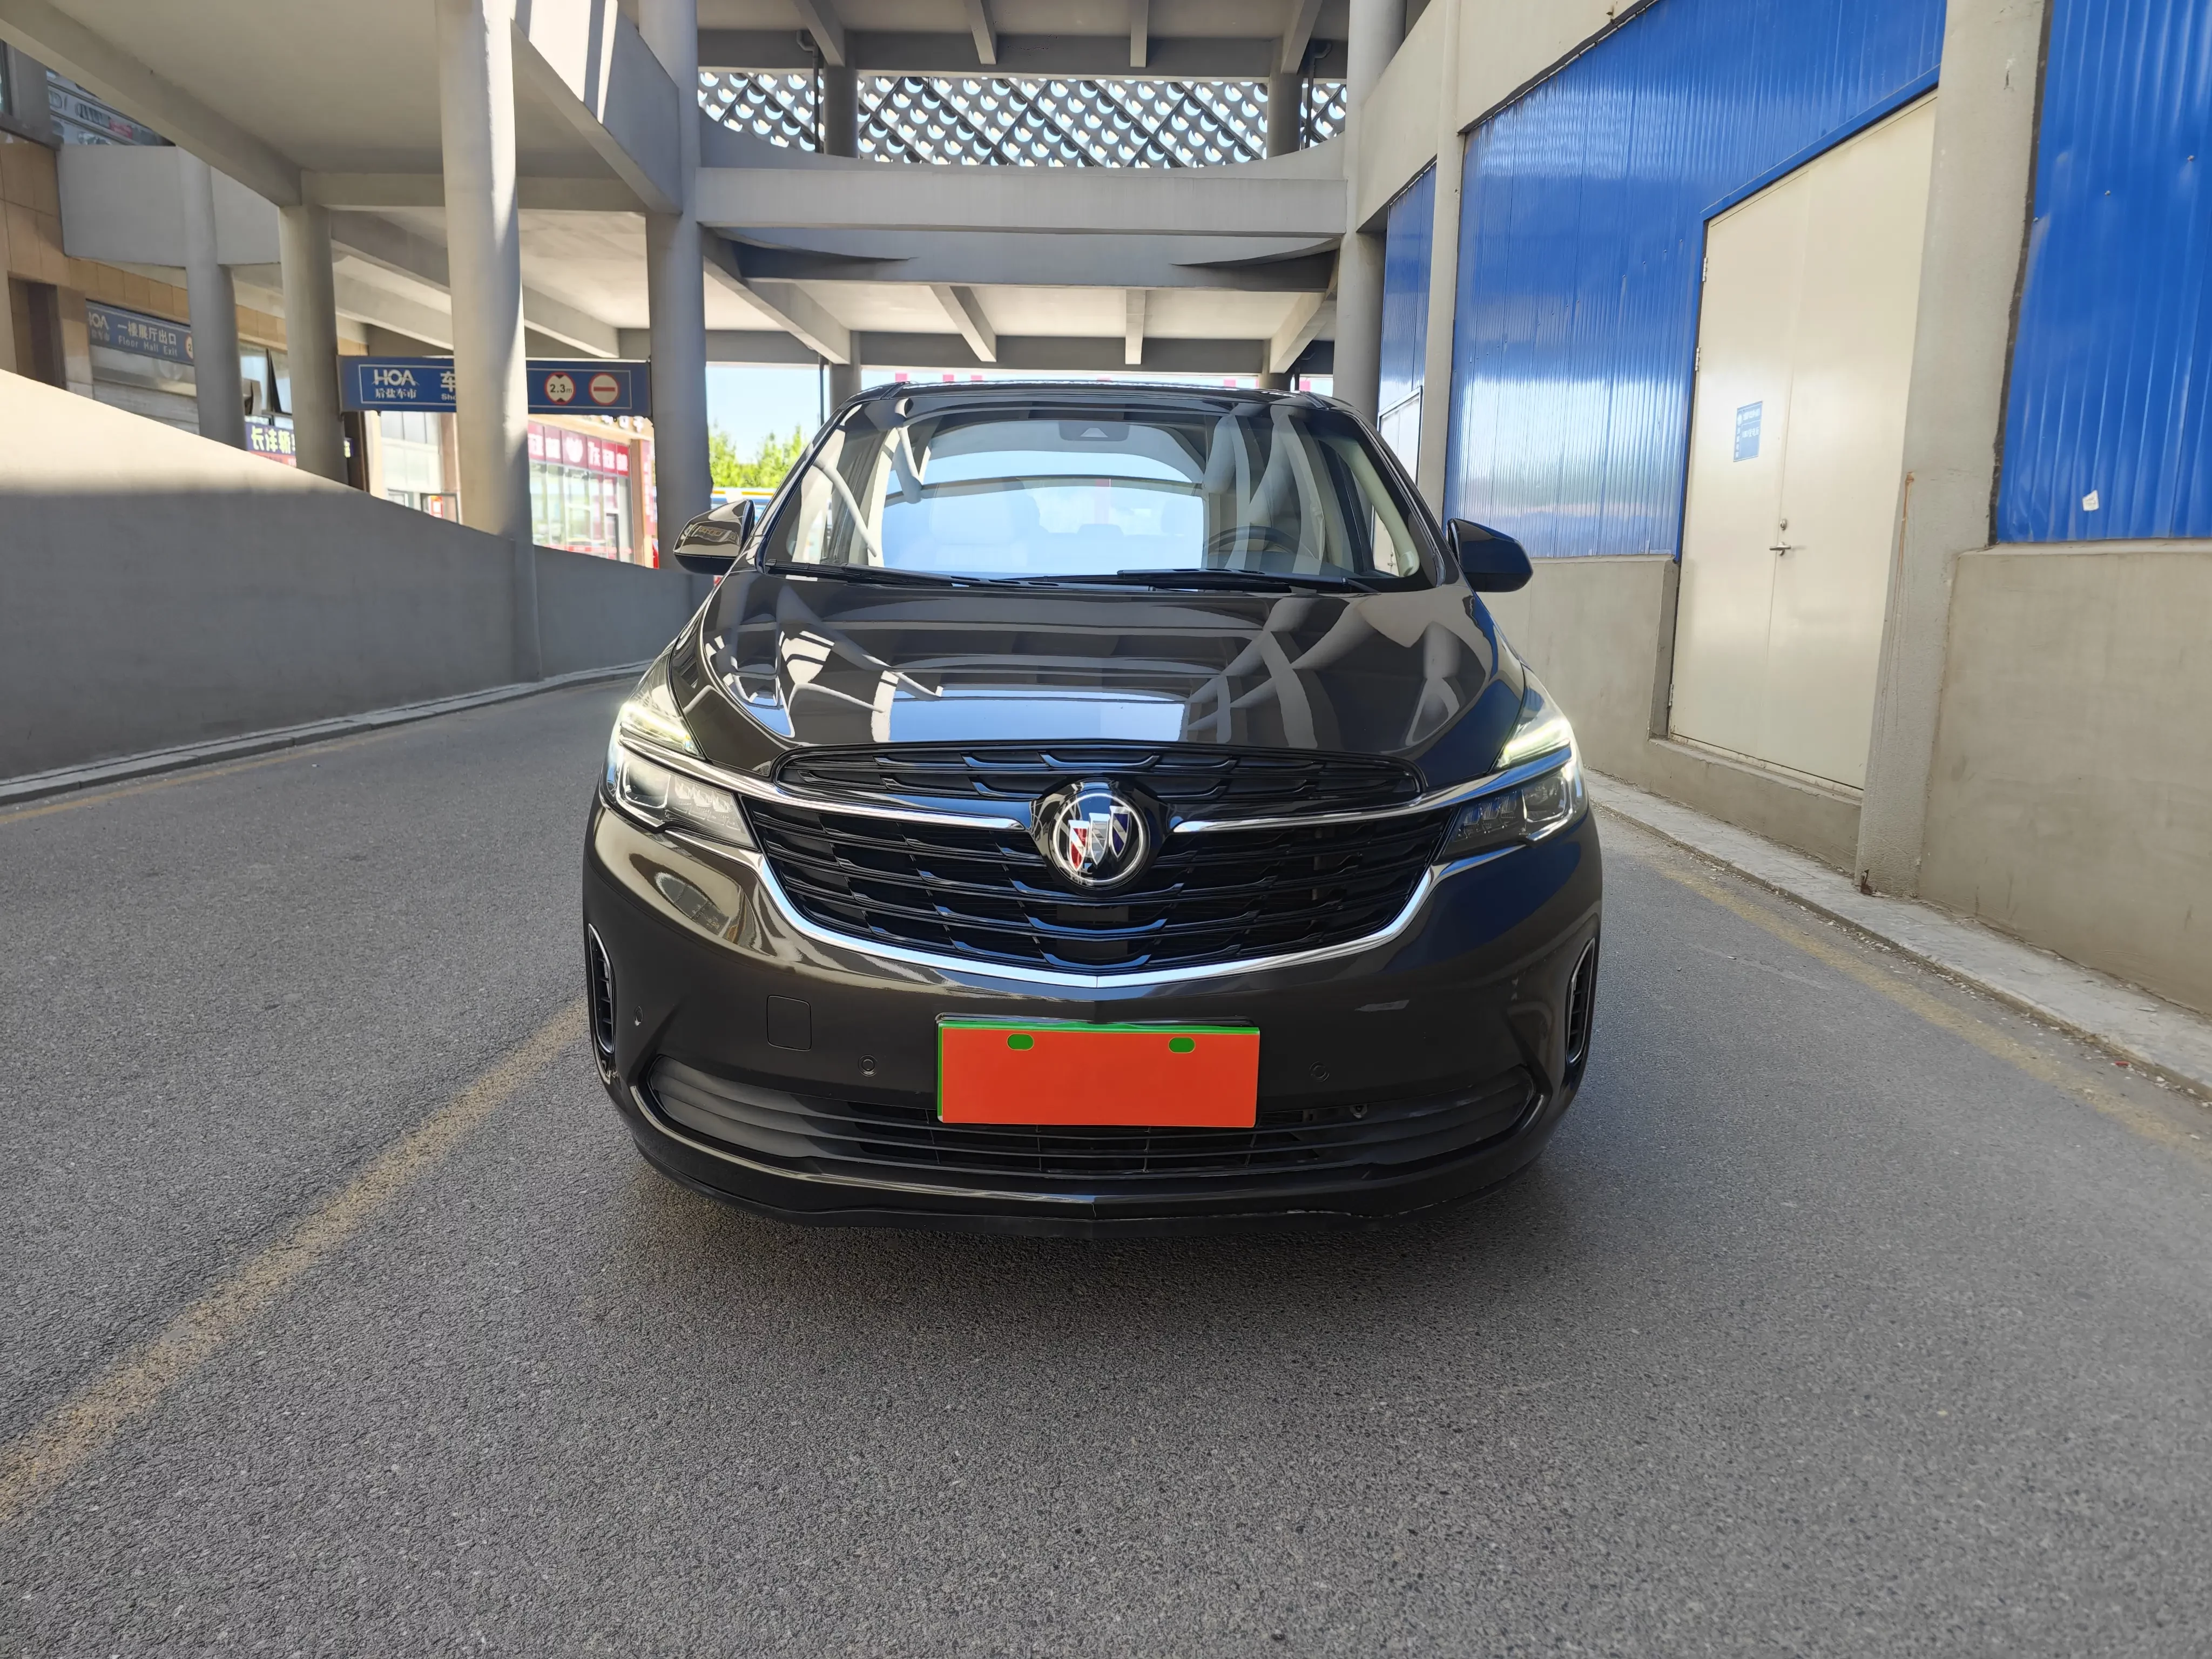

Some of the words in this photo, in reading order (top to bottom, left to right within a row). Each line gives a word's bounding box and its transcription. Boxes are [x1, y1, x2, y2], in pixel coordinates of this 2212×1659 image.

[118, 335, 138, 348] Floor
[143, 340, 159, 352] Hall
[163, 346, 178, 357] Exit
[373, 369, 418, 386] HOA
